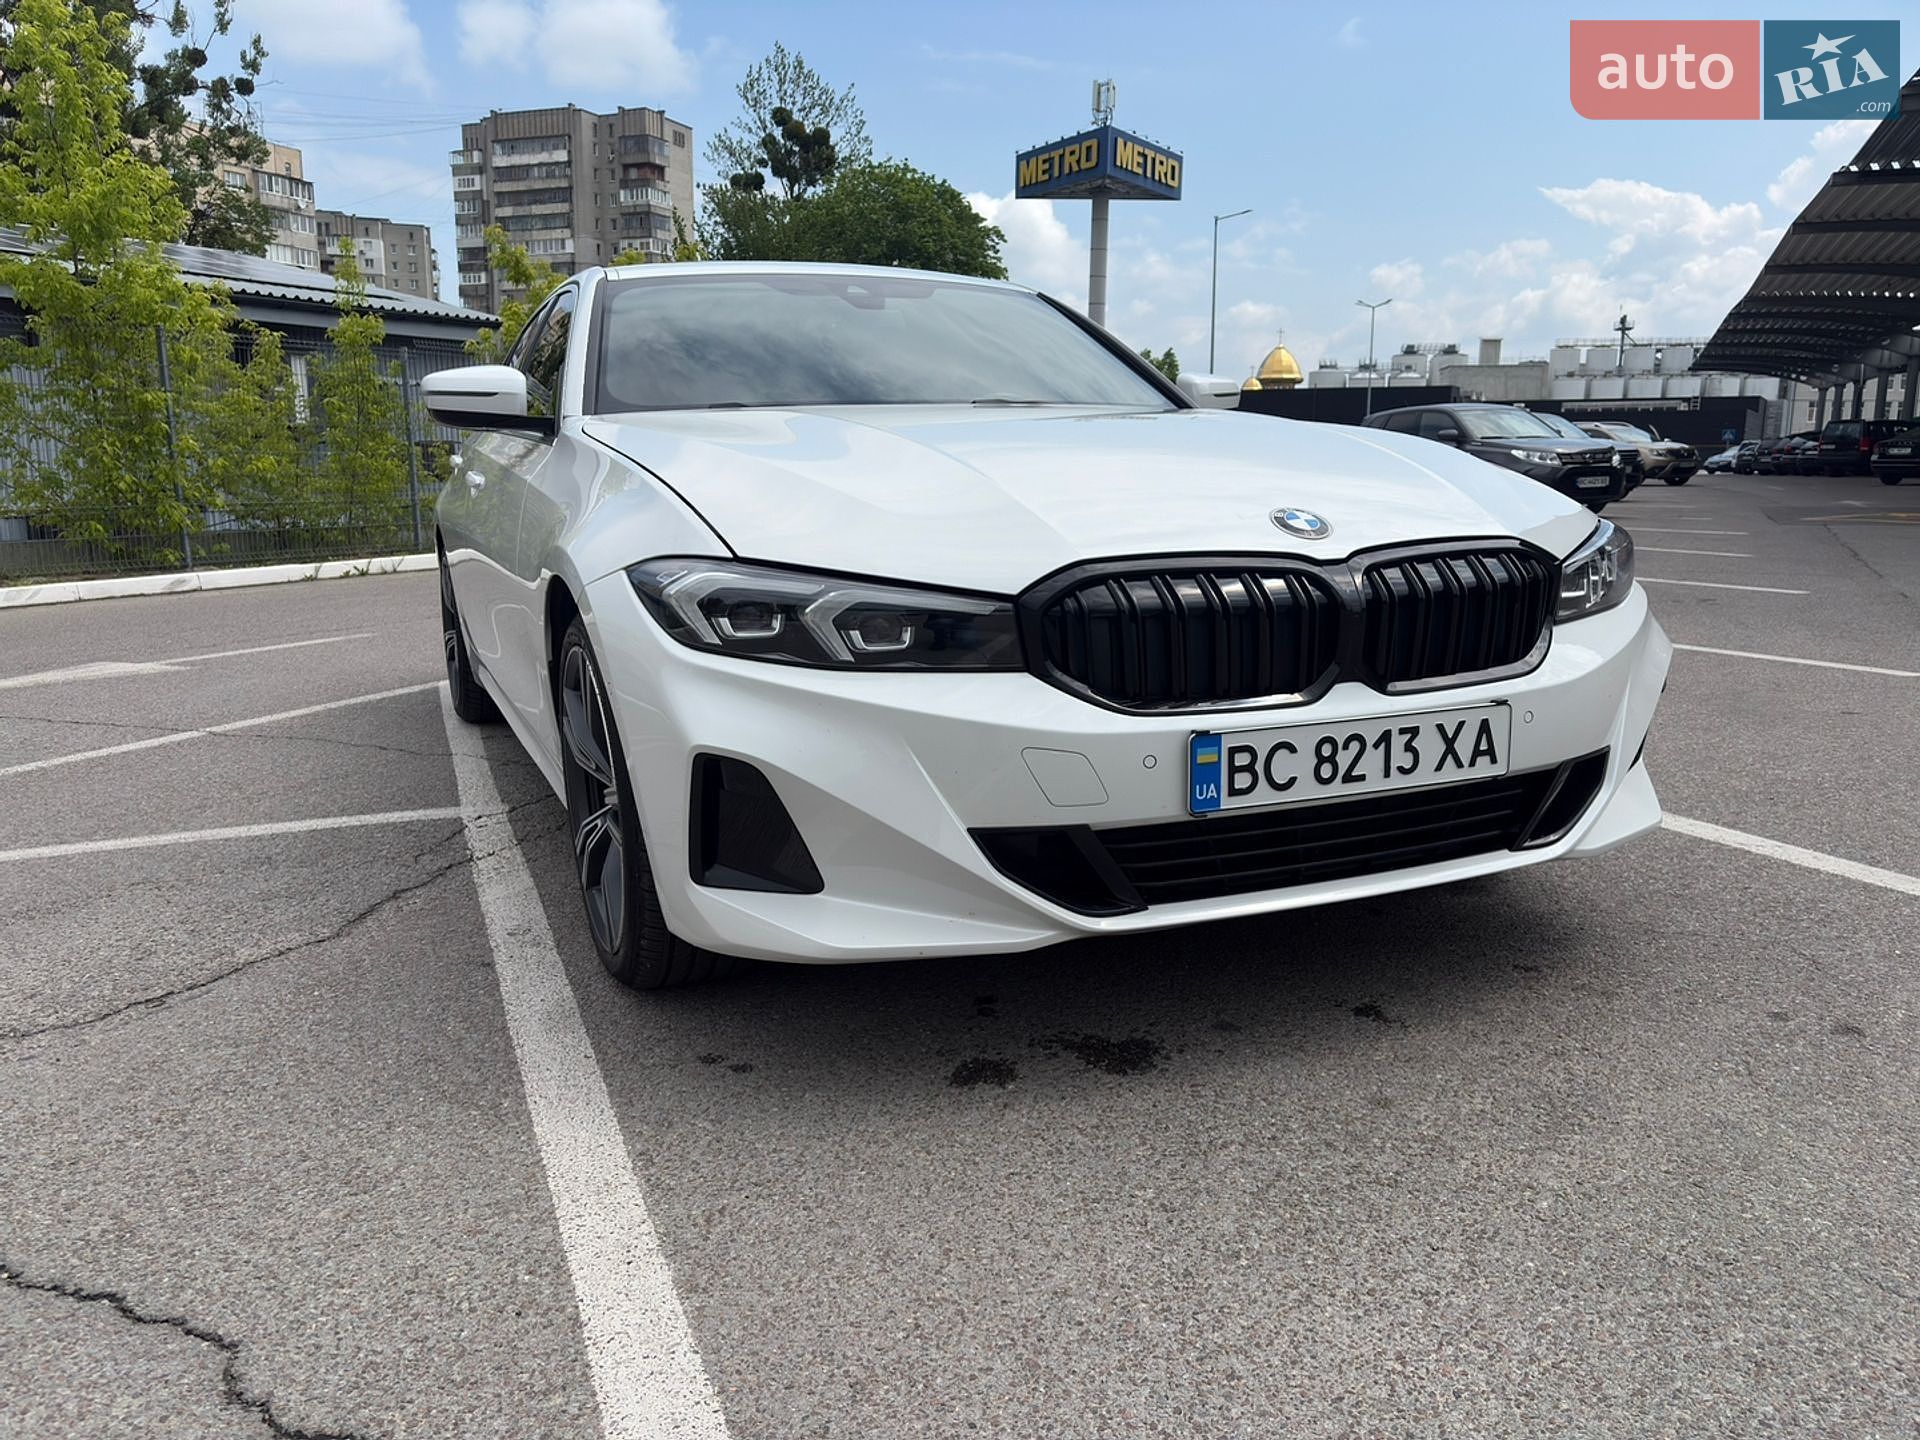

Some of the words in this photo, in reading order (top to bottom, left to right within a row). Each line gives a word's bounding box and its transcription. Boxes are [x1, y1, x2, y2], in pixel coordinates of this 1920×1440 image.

[1019, 138, 1099, 188] METRO
[1115, 136, 1180, 188] METRO
[1227, 741, 1298, 798] BC
[1313, 725, 1420, 785] 8213
[1434, 717, 1498, 772] XA
[1195, 782, 1217, 800] UA
